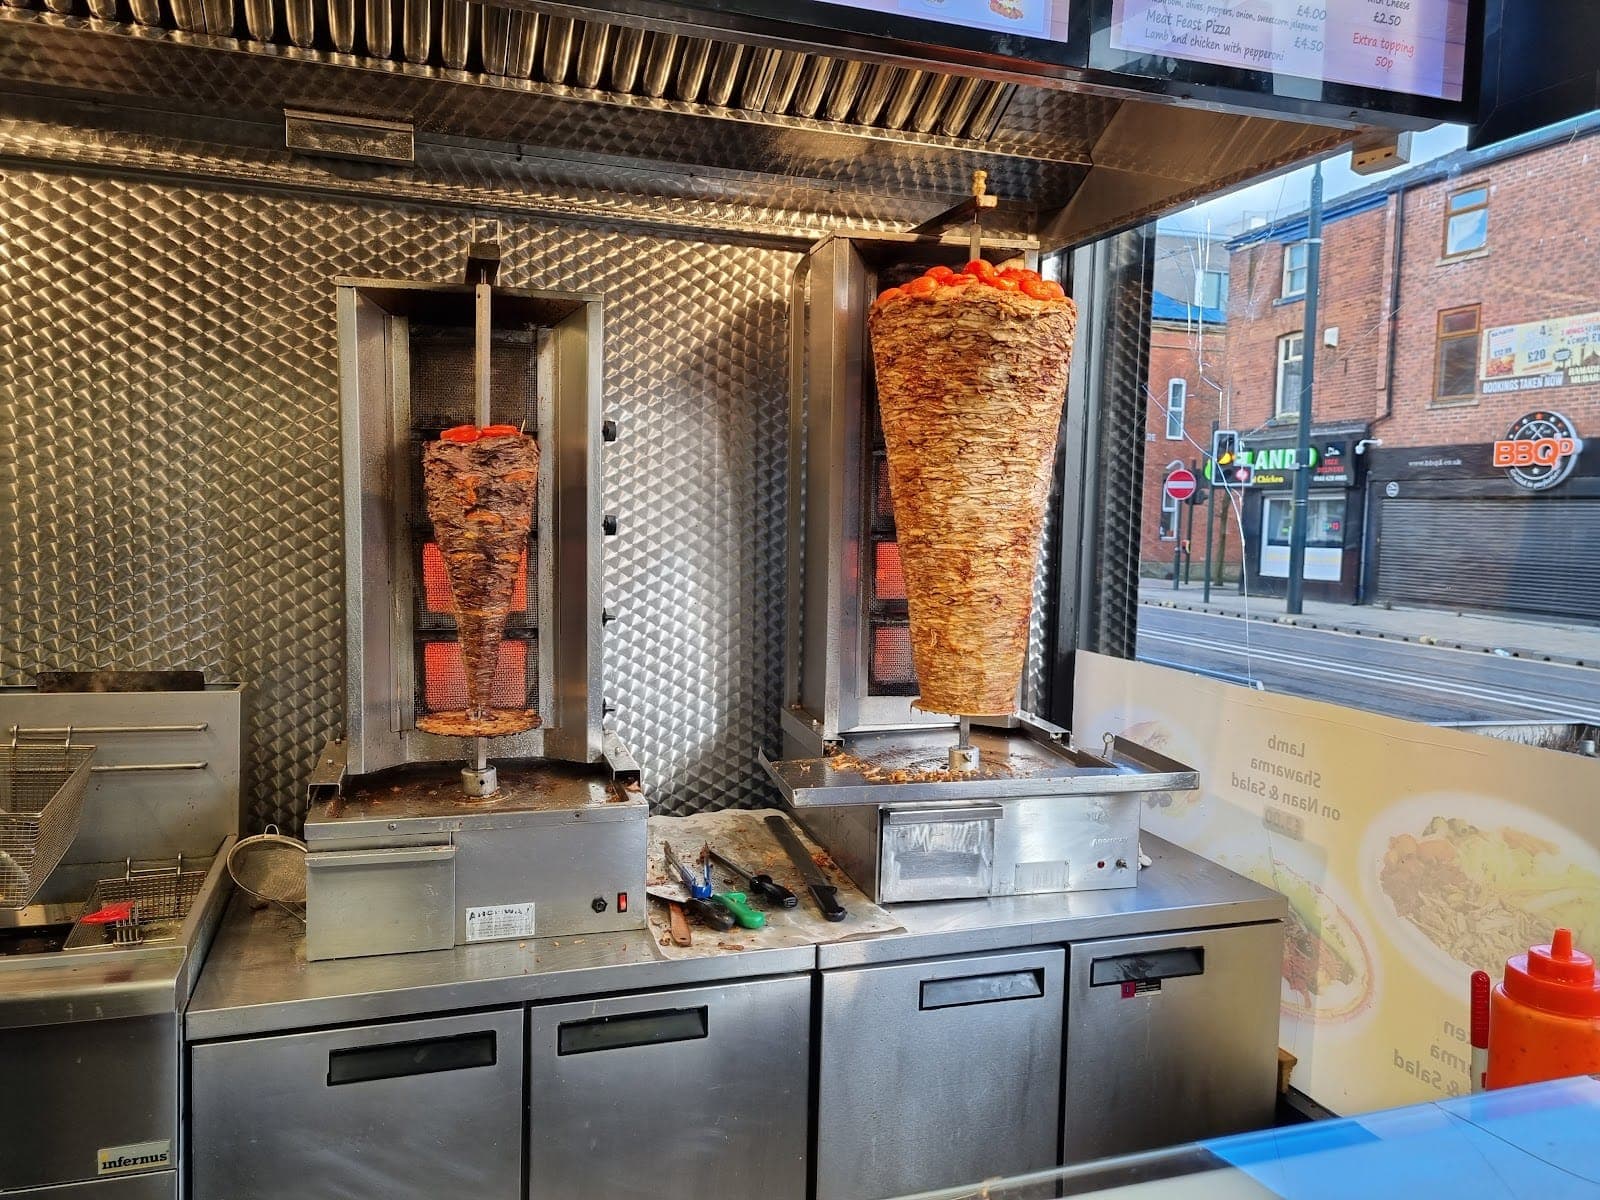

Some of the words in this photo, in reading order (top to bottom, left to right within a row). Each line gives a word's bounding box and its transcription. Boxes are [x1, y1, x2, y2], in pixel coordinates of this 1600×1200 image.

[1297, 4, 1327, 21] £4.00
[1373, 11, 1401, 26] £2.50
[1146, 9, 1172, 26] Meat
[1176, 15, 1201, 31] Feast
[1205, 19, 1231, 35] Pizza
[1145, 28, 1169, 40] Lamb
[1172, 31, 1187, 45] and
[1190, 36, 1220, 50] chicken
[1223, 41, 1241, 54] with
[1243, 47, 1285, 61] pepperoni
[1294, 36, 1324, 52] £4.50
[1353, 32, 1378, 47] Extra
[1380, 36, 1415, 58] topping
[1375, 56, 1394, 72] 50p
[1527, 349, 1546, 363] £20
[1482, 378, 1519, 394] BOOKINGS
[1520, 375, 1545, 390] TAKEN
[1544, 372, 1564, 388] NOW
[101, 1152, 168, 1169] infernus
